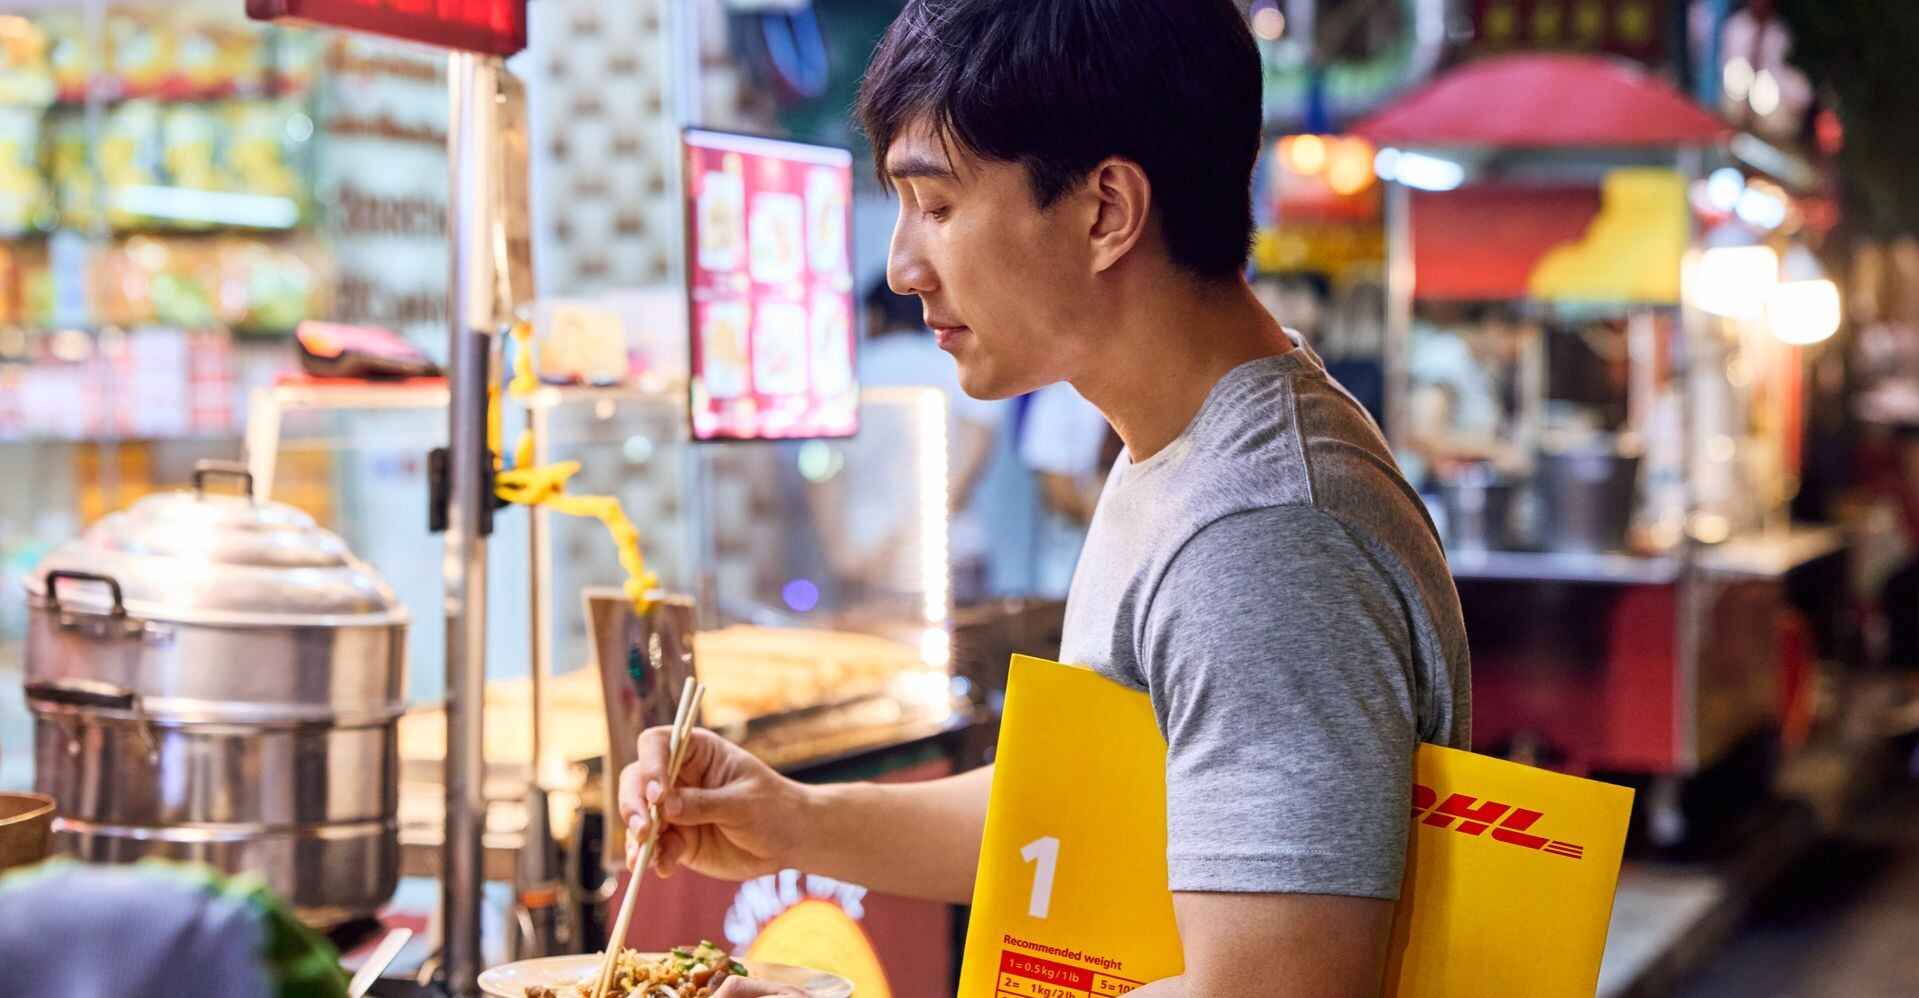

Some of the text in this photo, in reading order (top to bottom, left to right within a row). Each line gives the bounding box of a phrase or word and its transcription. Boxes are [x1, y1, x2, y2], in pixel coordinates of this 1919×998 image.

[1020, 835, 1060, 919] 1
[1003, 934, 1123, 970] Recommended weight
